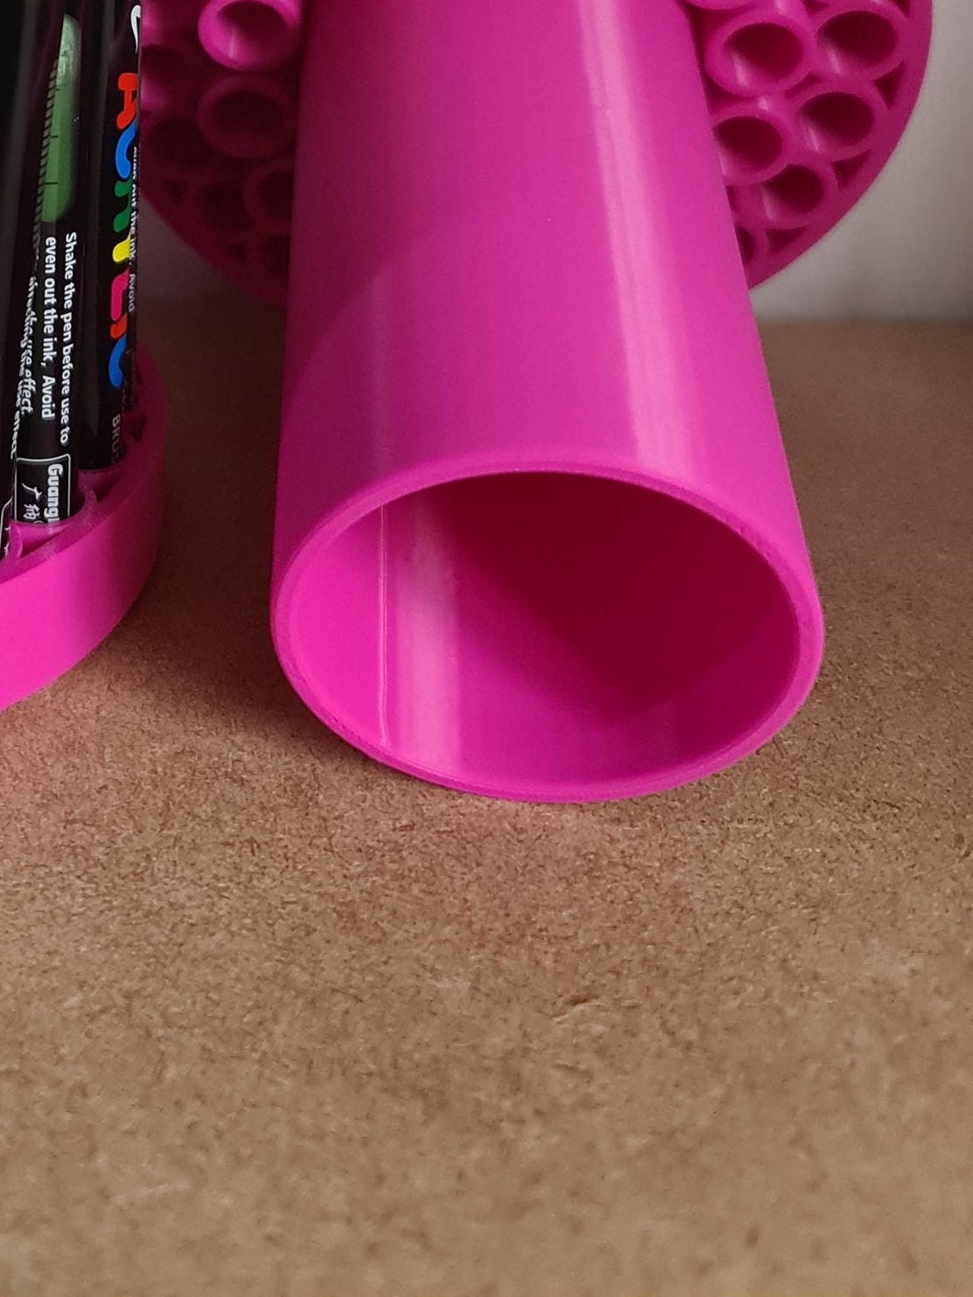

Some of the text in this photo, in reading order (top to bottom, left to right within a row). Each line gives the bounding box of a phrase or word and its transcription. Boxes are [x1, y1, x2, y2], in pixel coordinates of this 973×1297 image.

[45, 236, 57, 273] even
[44, 278, 56, 305] out
[43, 307, 58, 334] the
[60, 232, 77, 446] Shake the pen before use to
[41, 375, 57, 419] Avoid
